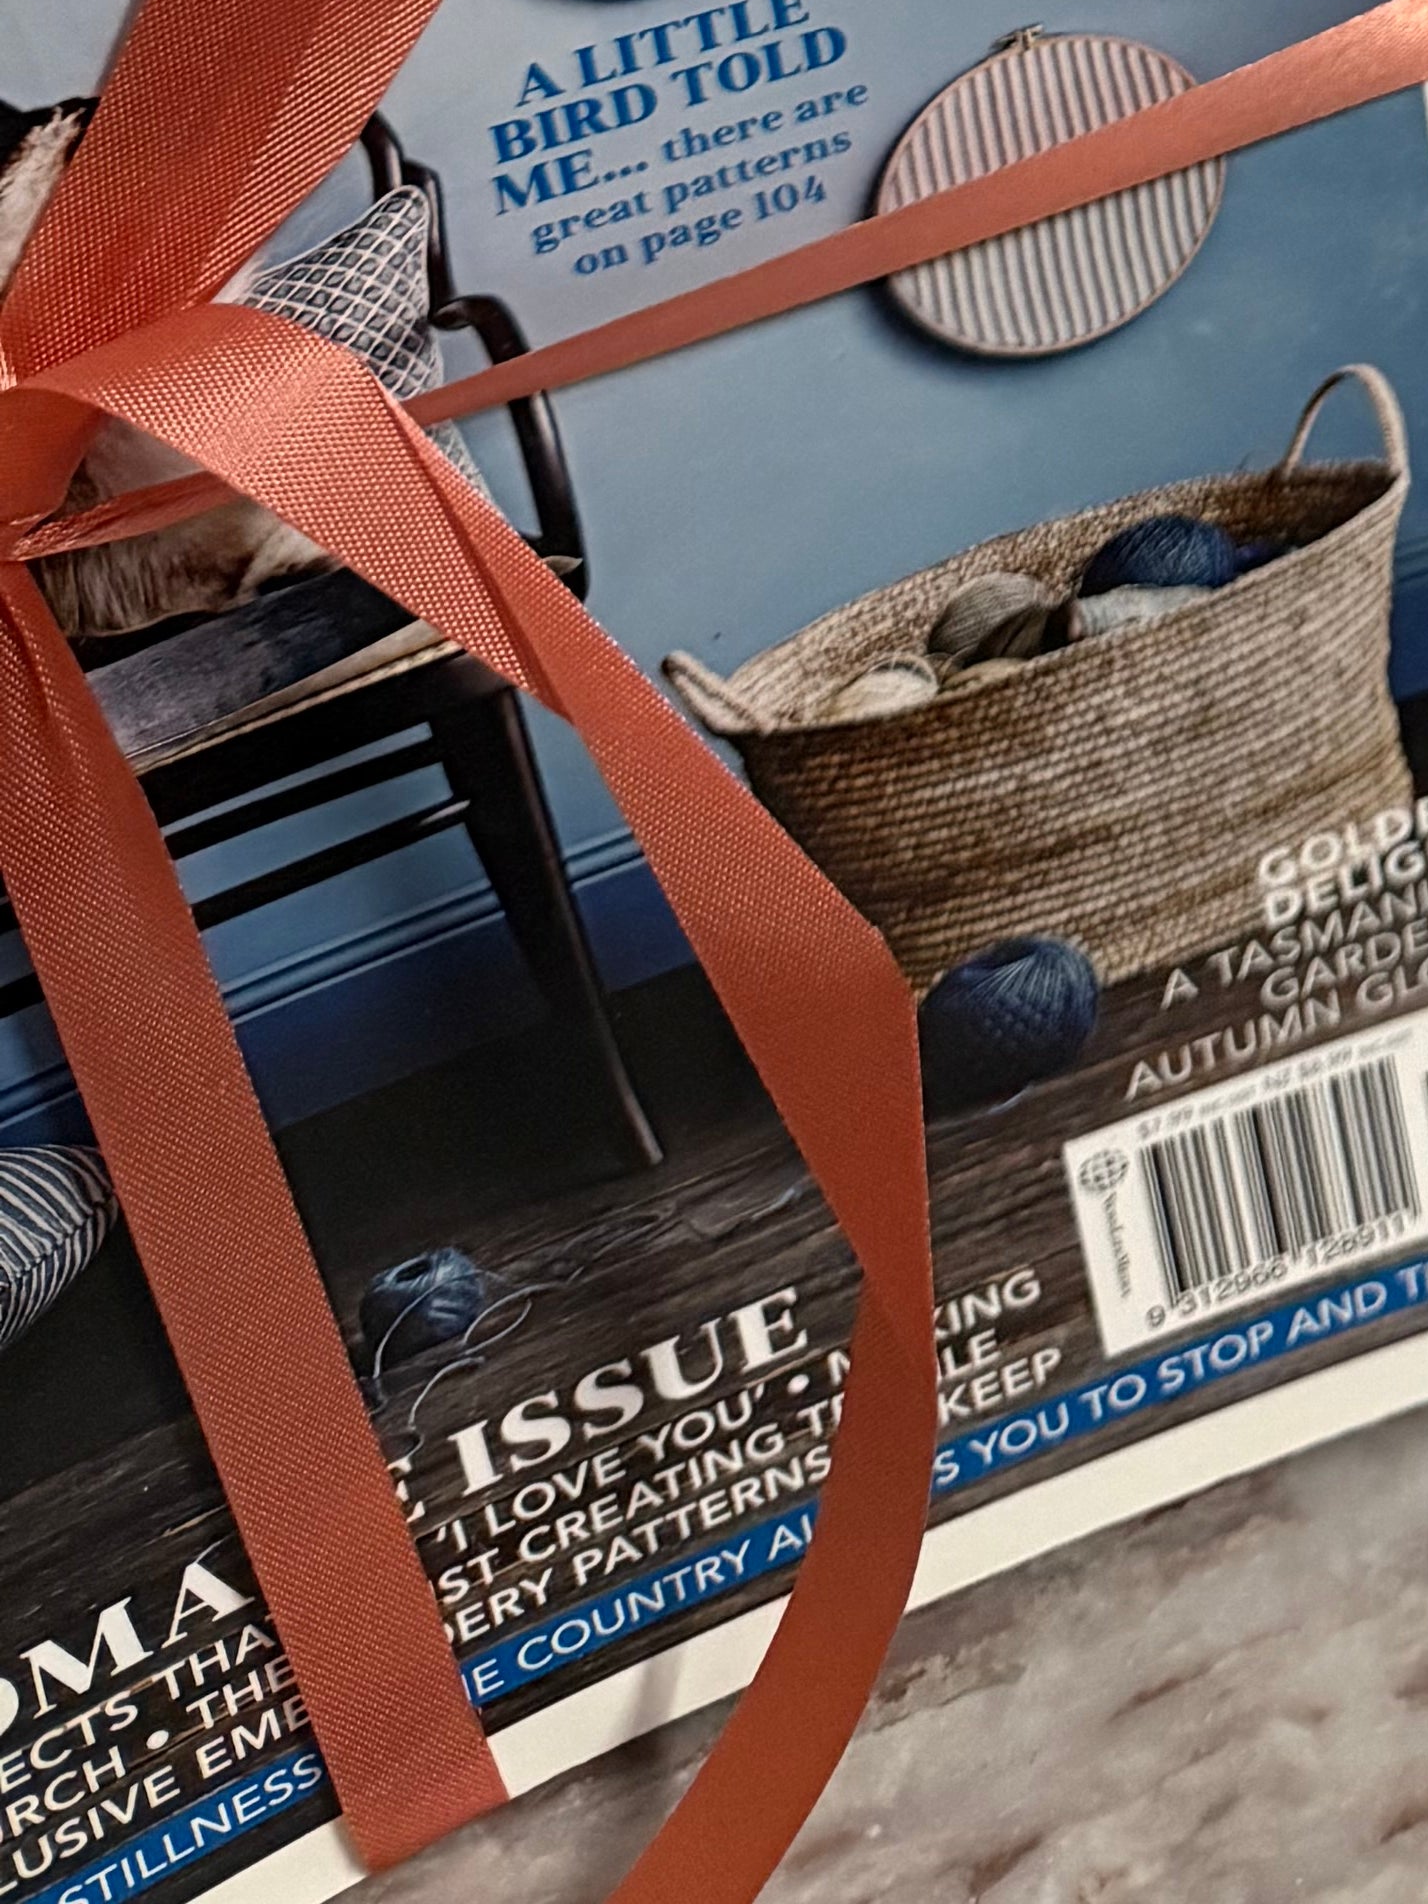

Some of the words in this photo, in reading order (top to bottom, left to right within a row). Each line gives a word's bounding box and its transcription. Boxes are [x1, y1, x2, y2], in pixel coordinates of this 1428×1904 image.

[488, 81, 659, 165] BIRD
[671, 25, 849, 108] TOLD
[491, 148, 649, 217] ME...
[662, 107, 784, 166] there
[795, 83, 871, 126] are
[514, 61, 568, 108] A
[531, 193, 652, 256] great
[662, 129, 854, 217] patterns
[573, 245, 629, 278] on
[640, 206, 744, 267] page
[754, 174, 829, 223] 104
[1123, 979, 1342, 1103] AUTUMN
[1158, 965, 1200, 1011] A
[447, 1286, 810, 1499] ISSUE
[516, 1540, 751, 1670] COUNTRY
[968, 1403, 1070, 1465] YOU
[1082, 1374, 1147, 1419] TO
[1157, 1321, 1274, 1391] STOP
[1286, 1280, 1388, 1343] AND
[516, 1423, 786, 1564] CREATING
[574, 1444, 832, 1587] PATTERNS
[938, 1347, 1063, 1428] KEEP
[149, 1623, 277, 1702] THA
[485, 1455, 628, 1539] LOVE
[636, 1383, 765, 1462] YOU'
